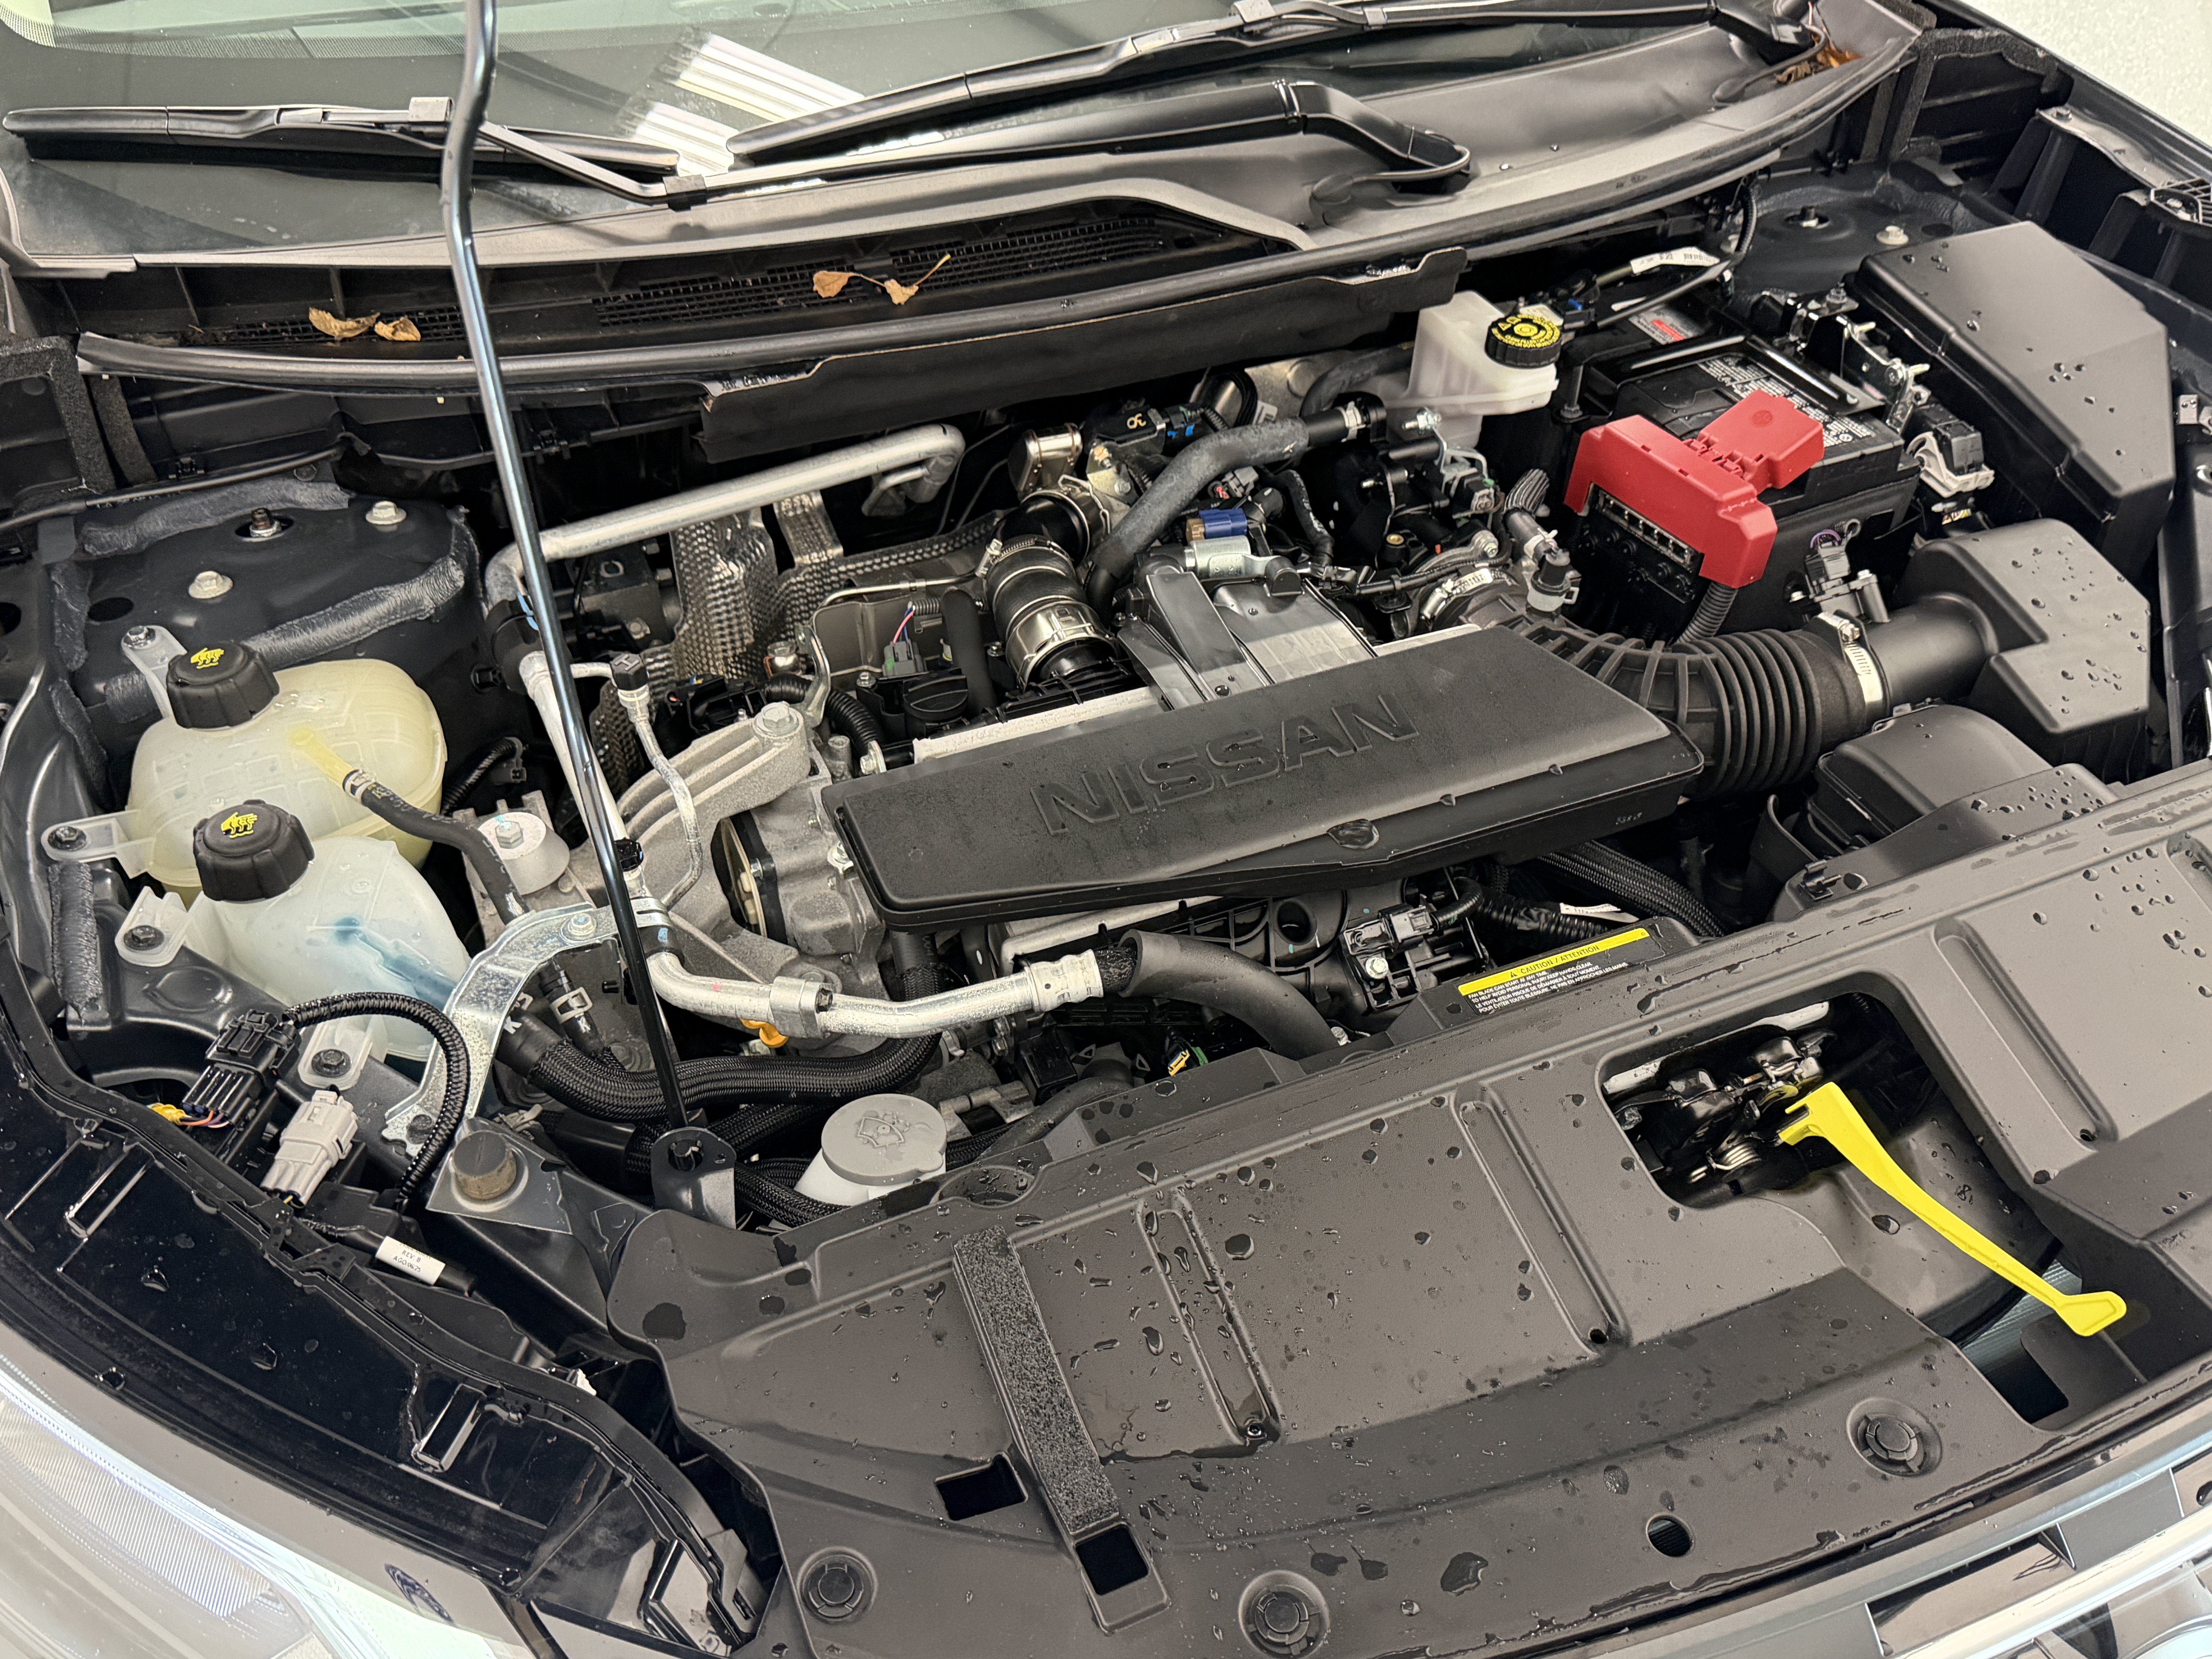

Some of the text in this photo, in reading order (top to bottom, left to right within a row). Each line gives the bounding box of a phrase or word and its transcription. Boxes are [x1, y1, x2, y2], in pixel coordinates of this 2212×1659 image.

[1029, 692, 1420, 836] NISSAN
[1520, 959, 1553, 974] CAUTION
[1561, 945, 1600, 962] ATTENTION
[1478, 986, 1494, 996] BLADE
[1505, 979, 1520, 988] START
[1479, 993, 1492, 1001] HELP
[1492, 989, 1507, 998] AVOID
[1506, 982, 1532, 994] PERSONAL
[1547, 971, 1560, 980] KEEP
[1559, 967, 1577, 975] HANDS
[1479, 1005, 1494, 1014] POUR
[1509, 994, 1526, 1003] TOUTE
[1558, 980, 1568, 989] PAS
[1603, 966, 1613, 974] LES
[1482, 994, 1513, 1007] VENTILATEUR
[1566, 970, 1580, 979] TOUT
